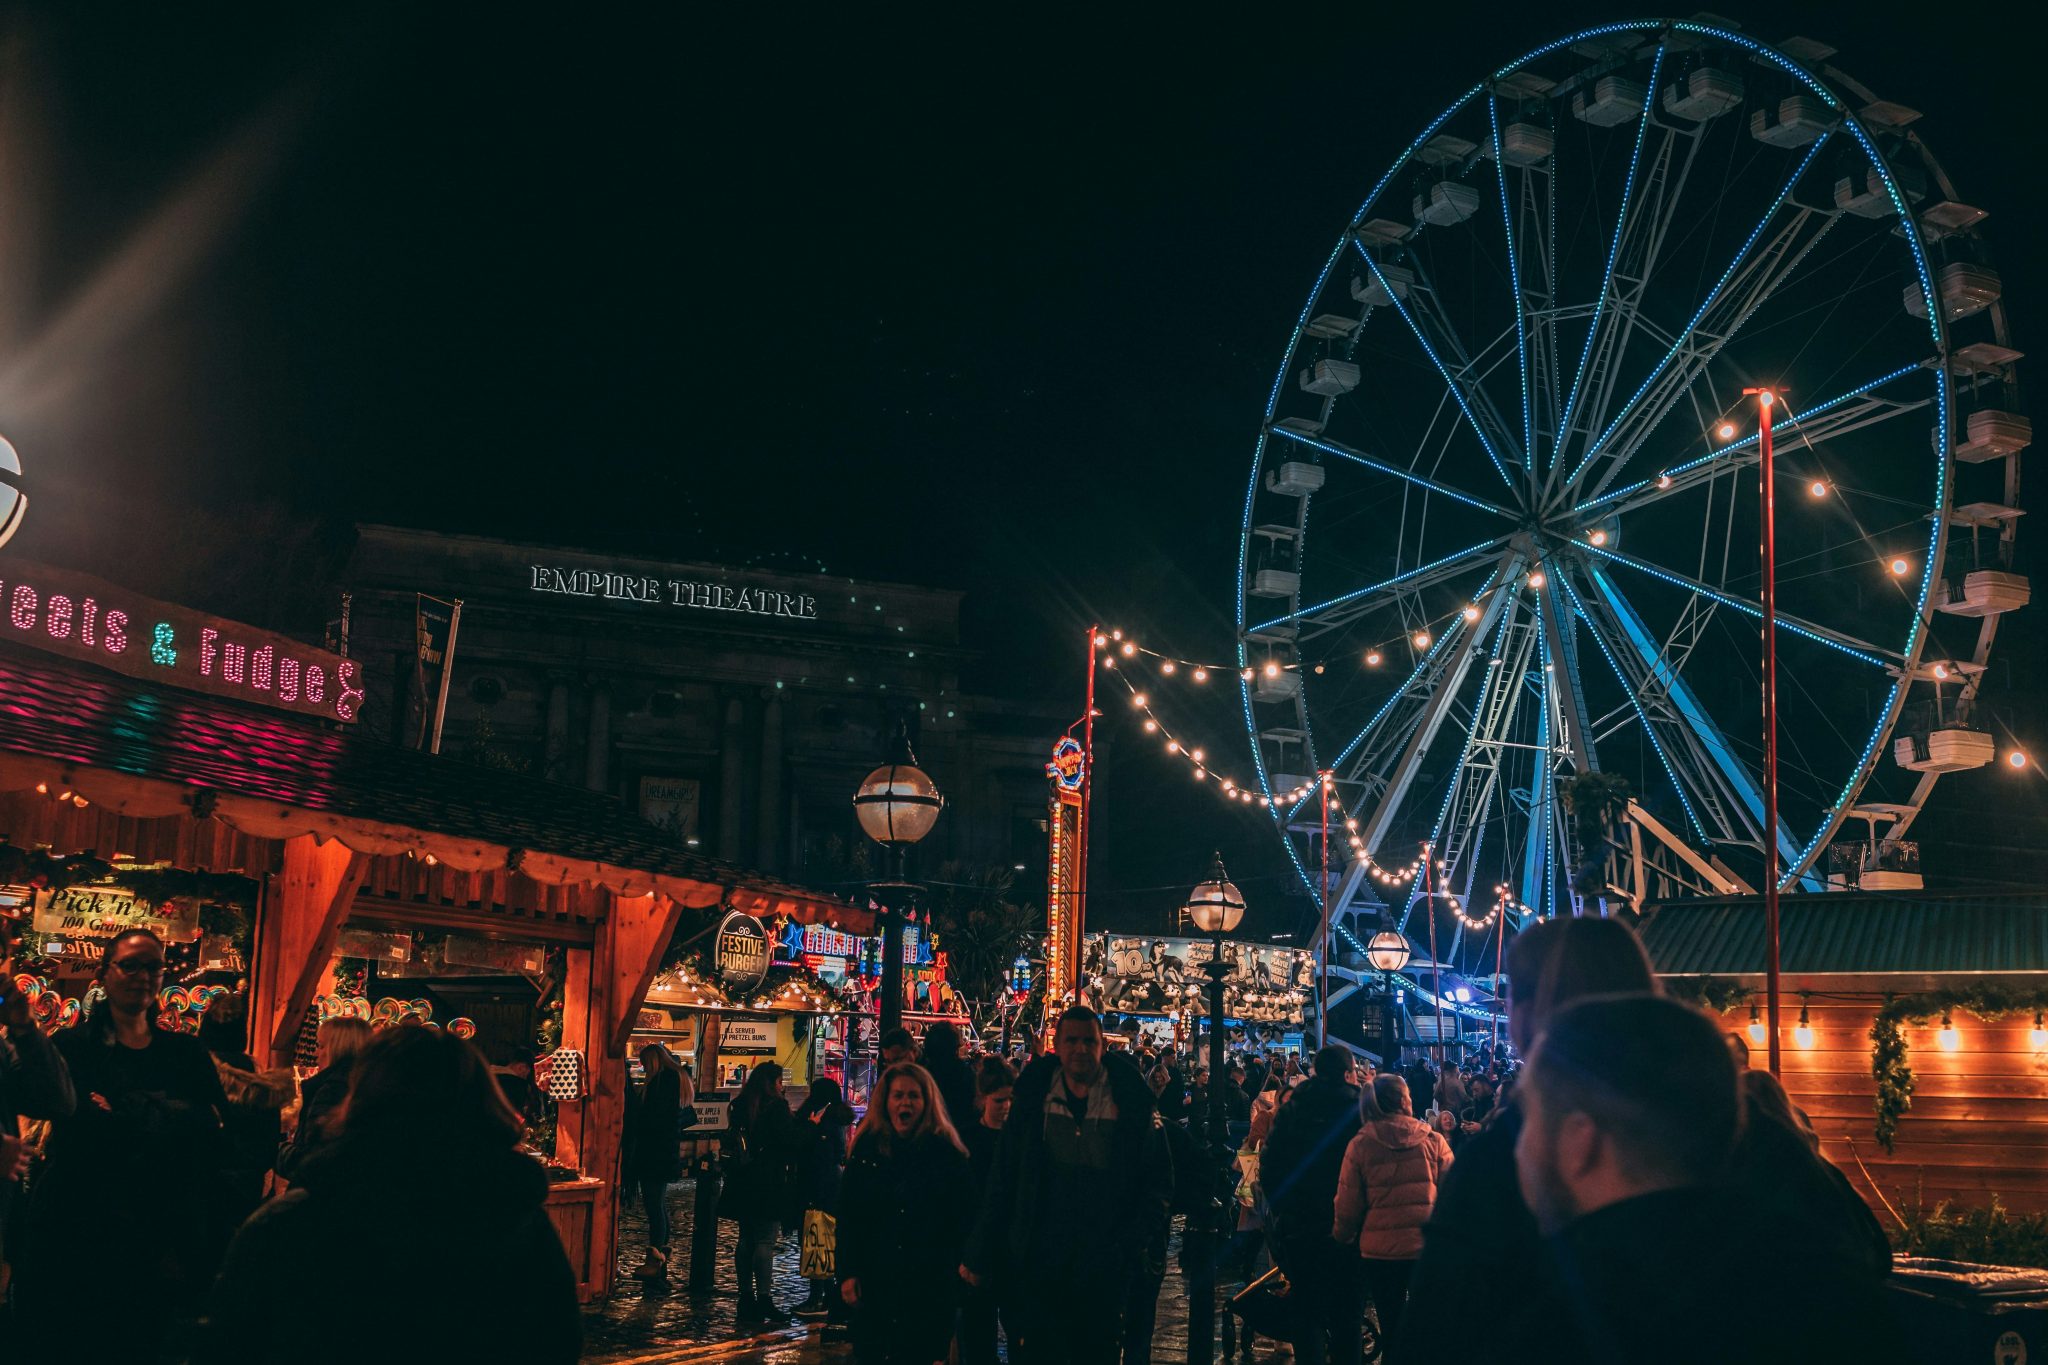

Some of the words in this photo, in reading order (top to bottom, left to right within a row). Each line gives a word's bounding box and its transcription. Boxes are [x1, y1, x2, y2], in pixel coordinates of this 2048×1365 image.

[530, 564, 662, 603] EMPIRE
[669, 579, 817, 619] THEATRE
[0, 579, 129, 653] eets
[151, 622, 177, 668] &
[200, 626, 325, 704] Fudge
[46, 889, 105, 914] Pick
[60, 916, 85, 930] 100
[721, 934, 765, 956] FESTIVE
[721, 951, 764, 973] BURGER
[1111, 949, 1144, 976] 10
